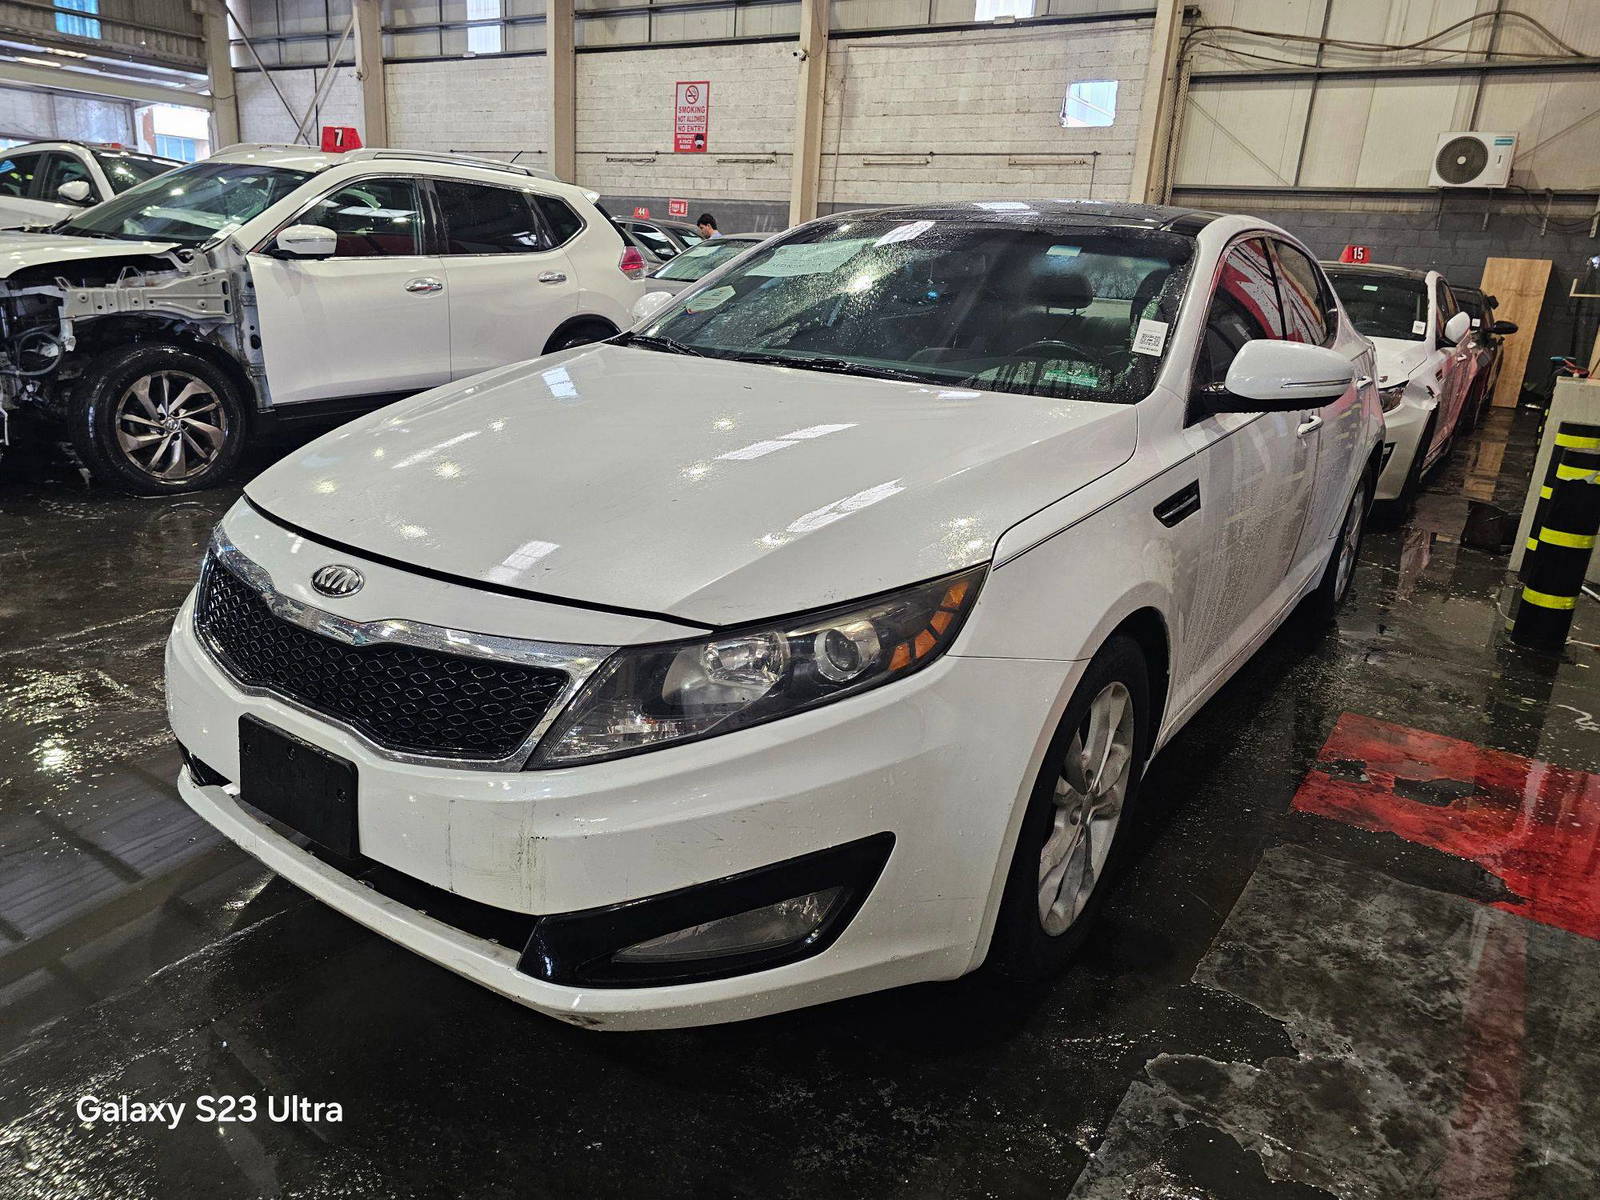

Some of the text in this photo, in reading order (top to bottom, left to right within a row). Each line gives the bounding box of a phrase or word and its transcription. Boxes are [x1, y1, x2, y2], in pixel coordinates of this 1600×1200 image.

[335, 129, 343, 147] 7
[1353, 247, 1364, 260] 15
[314, 567, 354, 593] KIA
